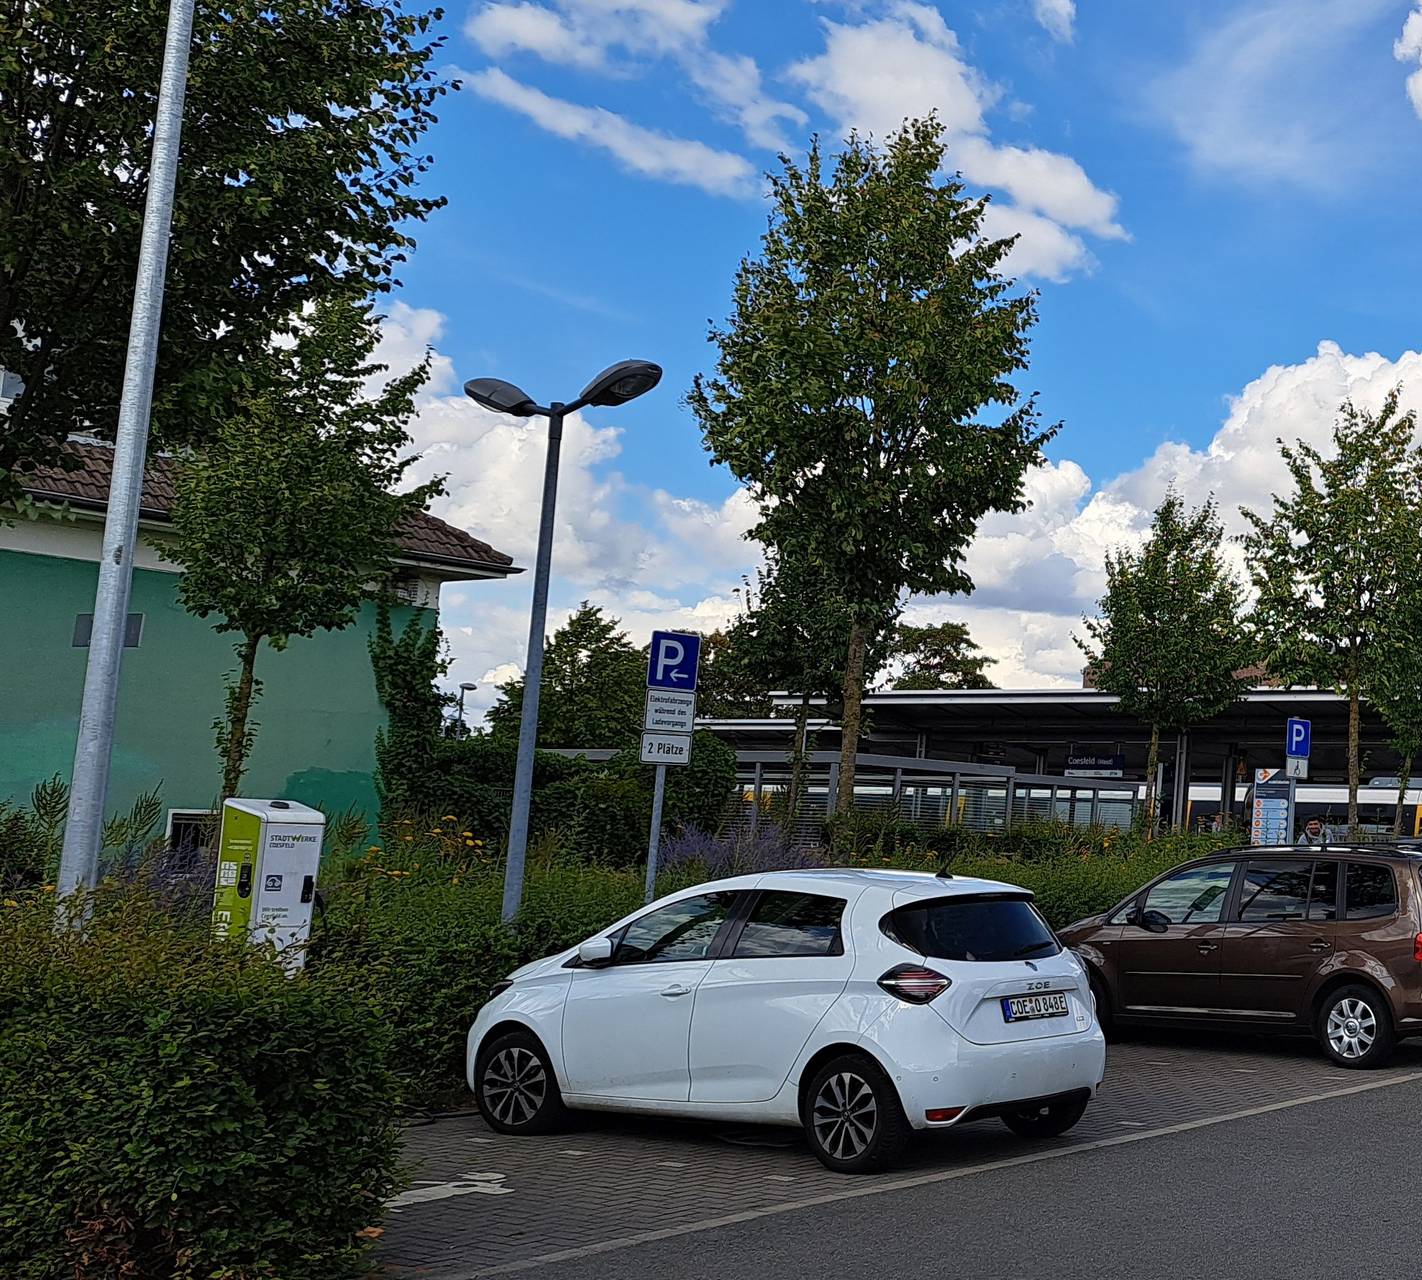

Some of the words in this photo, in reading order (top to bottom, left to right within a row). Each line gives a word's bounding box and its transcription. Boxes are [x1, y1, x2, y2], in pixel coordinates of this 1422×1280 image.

[656, 639, 684, 680] P
[1292, 724, 1305, 752] P
[648, 742, 654, 754] 2
[657, 742, 684, 755] Plätze
[270, 834, 317, 843] STADTWERKE
[1026, 981, 1051, 991] ZOE
[1010, 999, 1030, 1016] COE
[1043, 996, 1066, 1012] 848E
